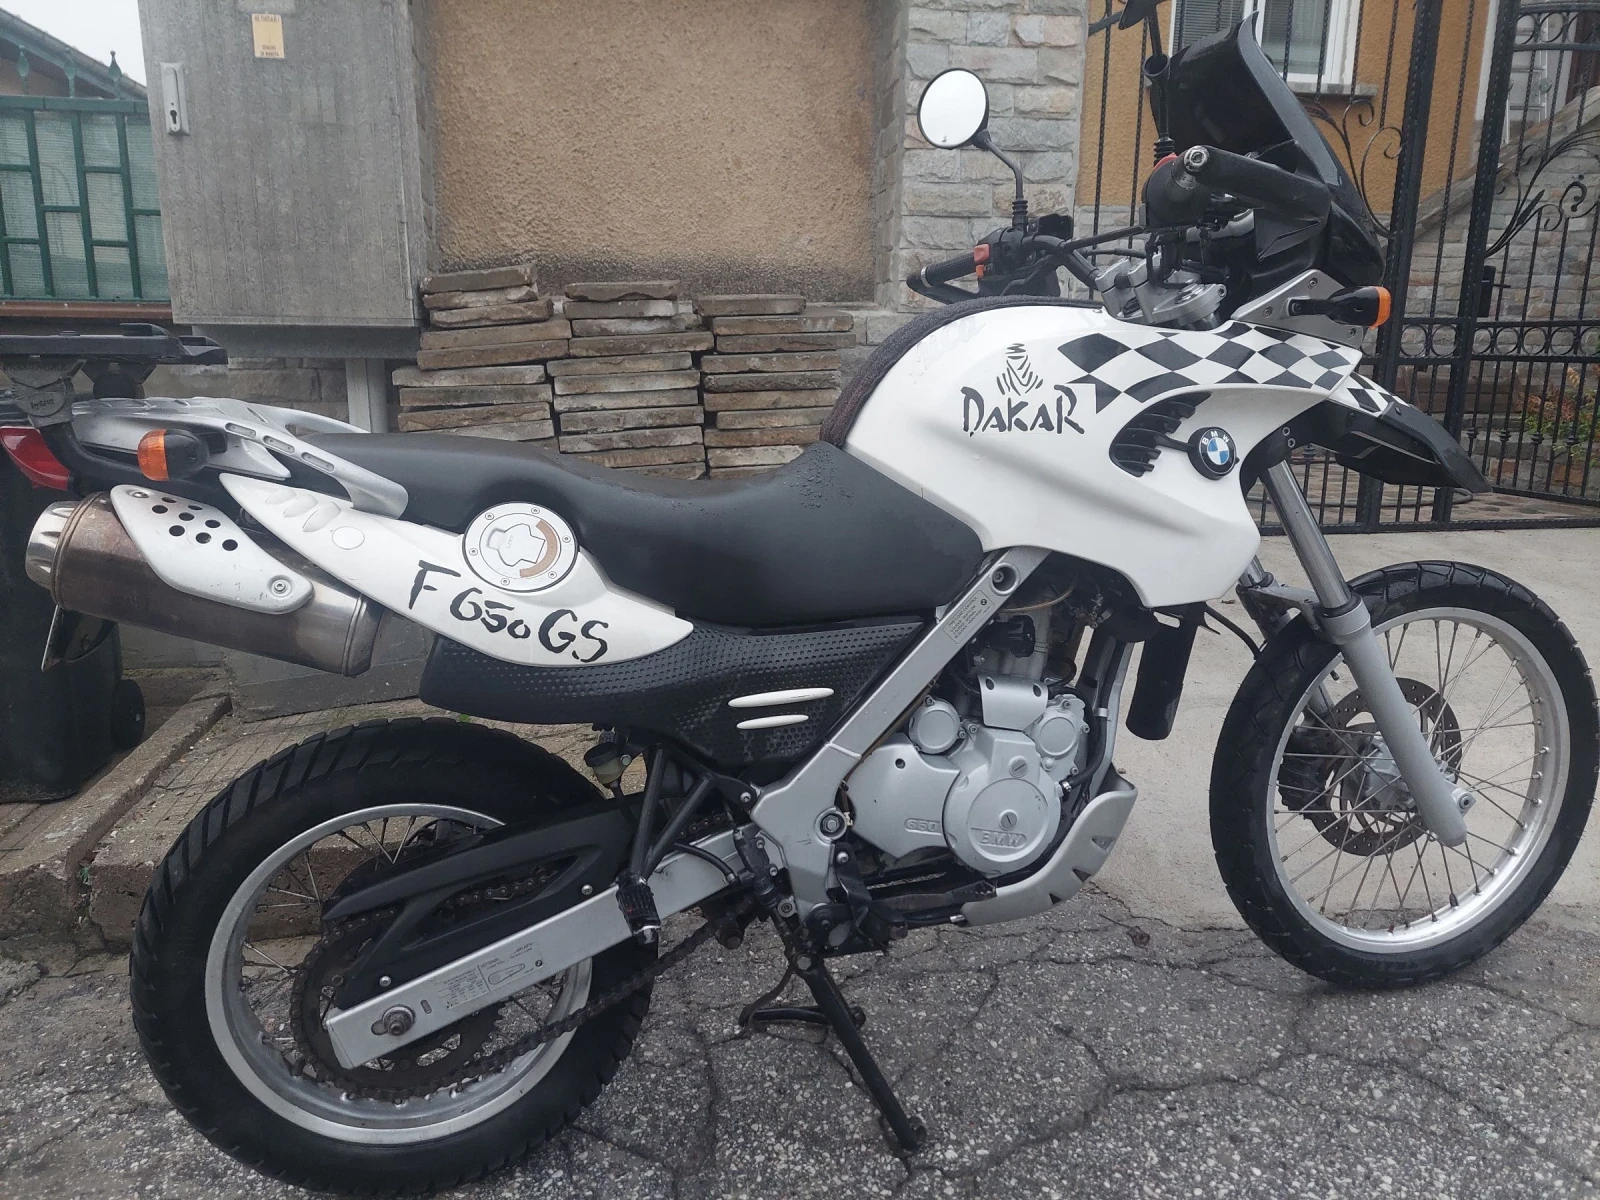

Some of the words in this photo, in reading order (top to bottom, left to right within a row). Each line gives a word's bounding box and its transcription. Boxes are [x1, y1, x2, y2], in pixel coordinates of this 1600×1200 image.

[960, 384, 1085, 437] DAKAR
[1202, 430, 1230, 446] BMW
[408, 559, 462, 610] F
[905, 819, 938, 832] 650
[981, 830, 1023, 848] BMW
